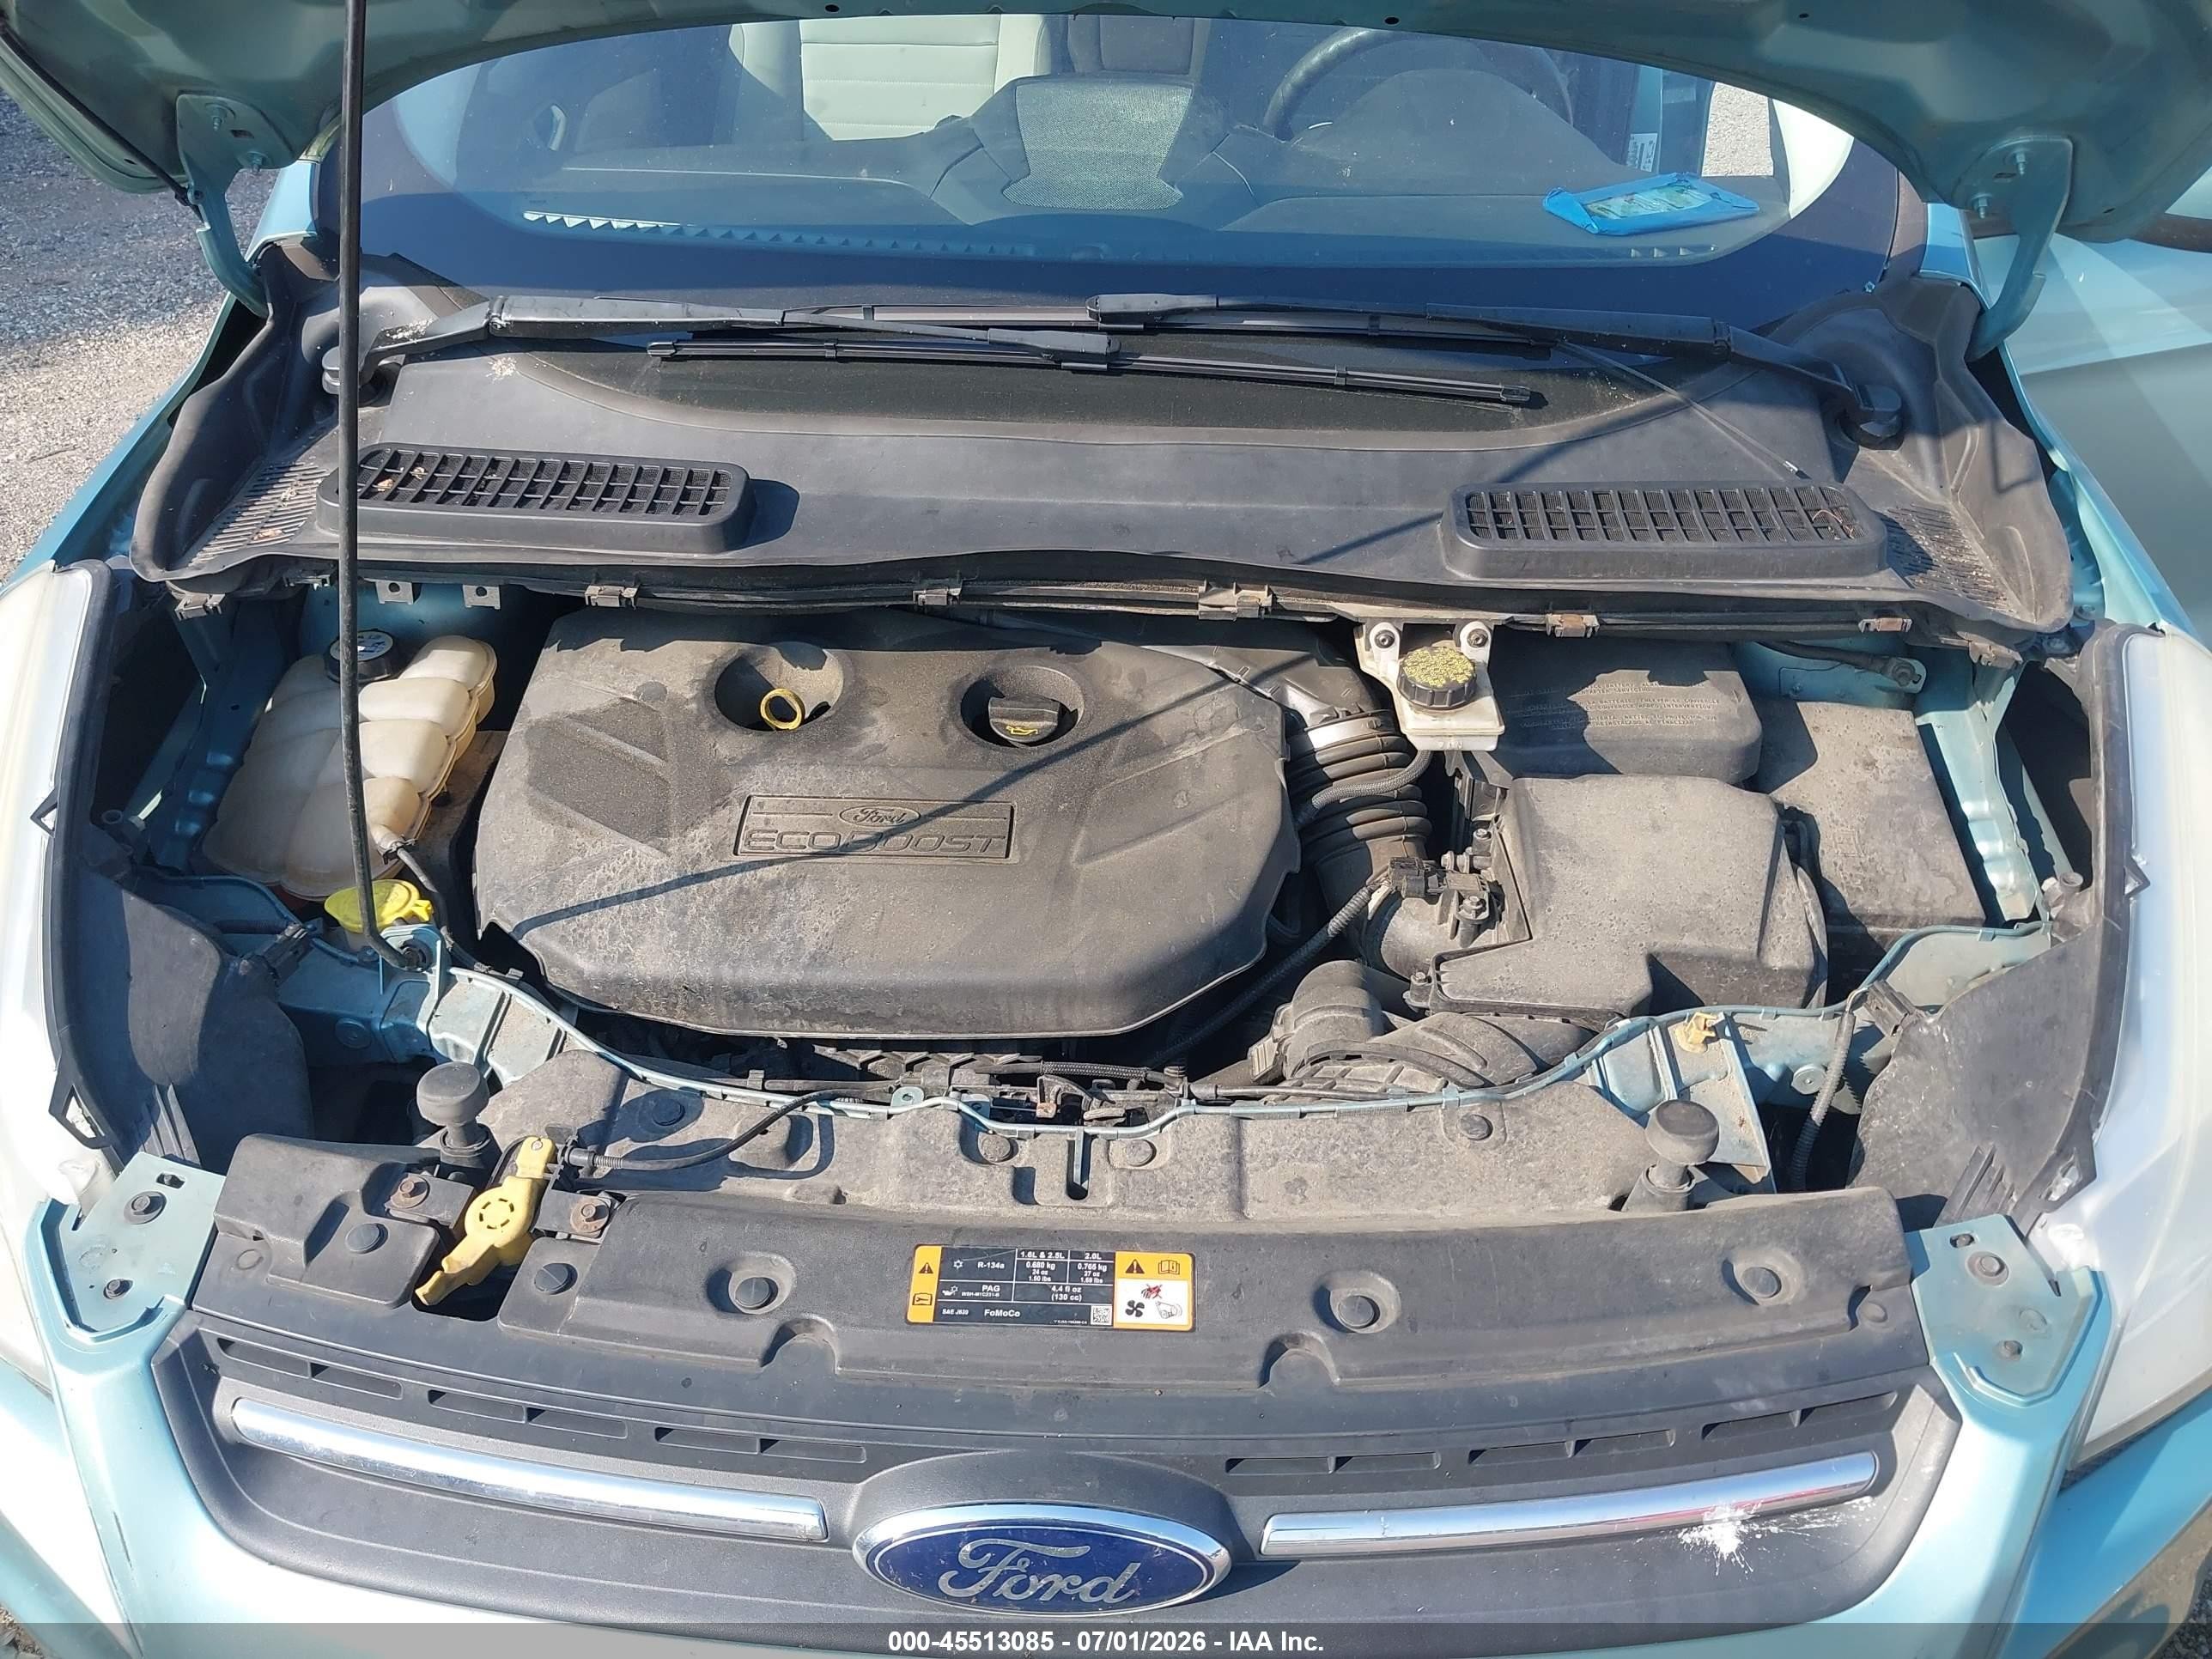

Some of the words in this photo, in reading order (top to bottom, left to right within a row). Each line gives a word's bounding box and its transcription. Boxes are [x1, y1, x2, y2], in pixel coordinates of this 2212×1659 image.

[852, 807, 907, 824] Ford
[744, 829, 1008, 854] ECOBOOST
[977, 1261, 1005, 1269] R-134a
[1046, 1261, 1056, 1270] kg
[1097, 1263, 1108, 1273] kg
[1051, 1293, 1068, 1302] (130
[1069, 1294, 1082, 1303] cc)
[984, 1309, 1021, 1317] FoMoCo
[938, 1538, 1141, 1603] Ford
